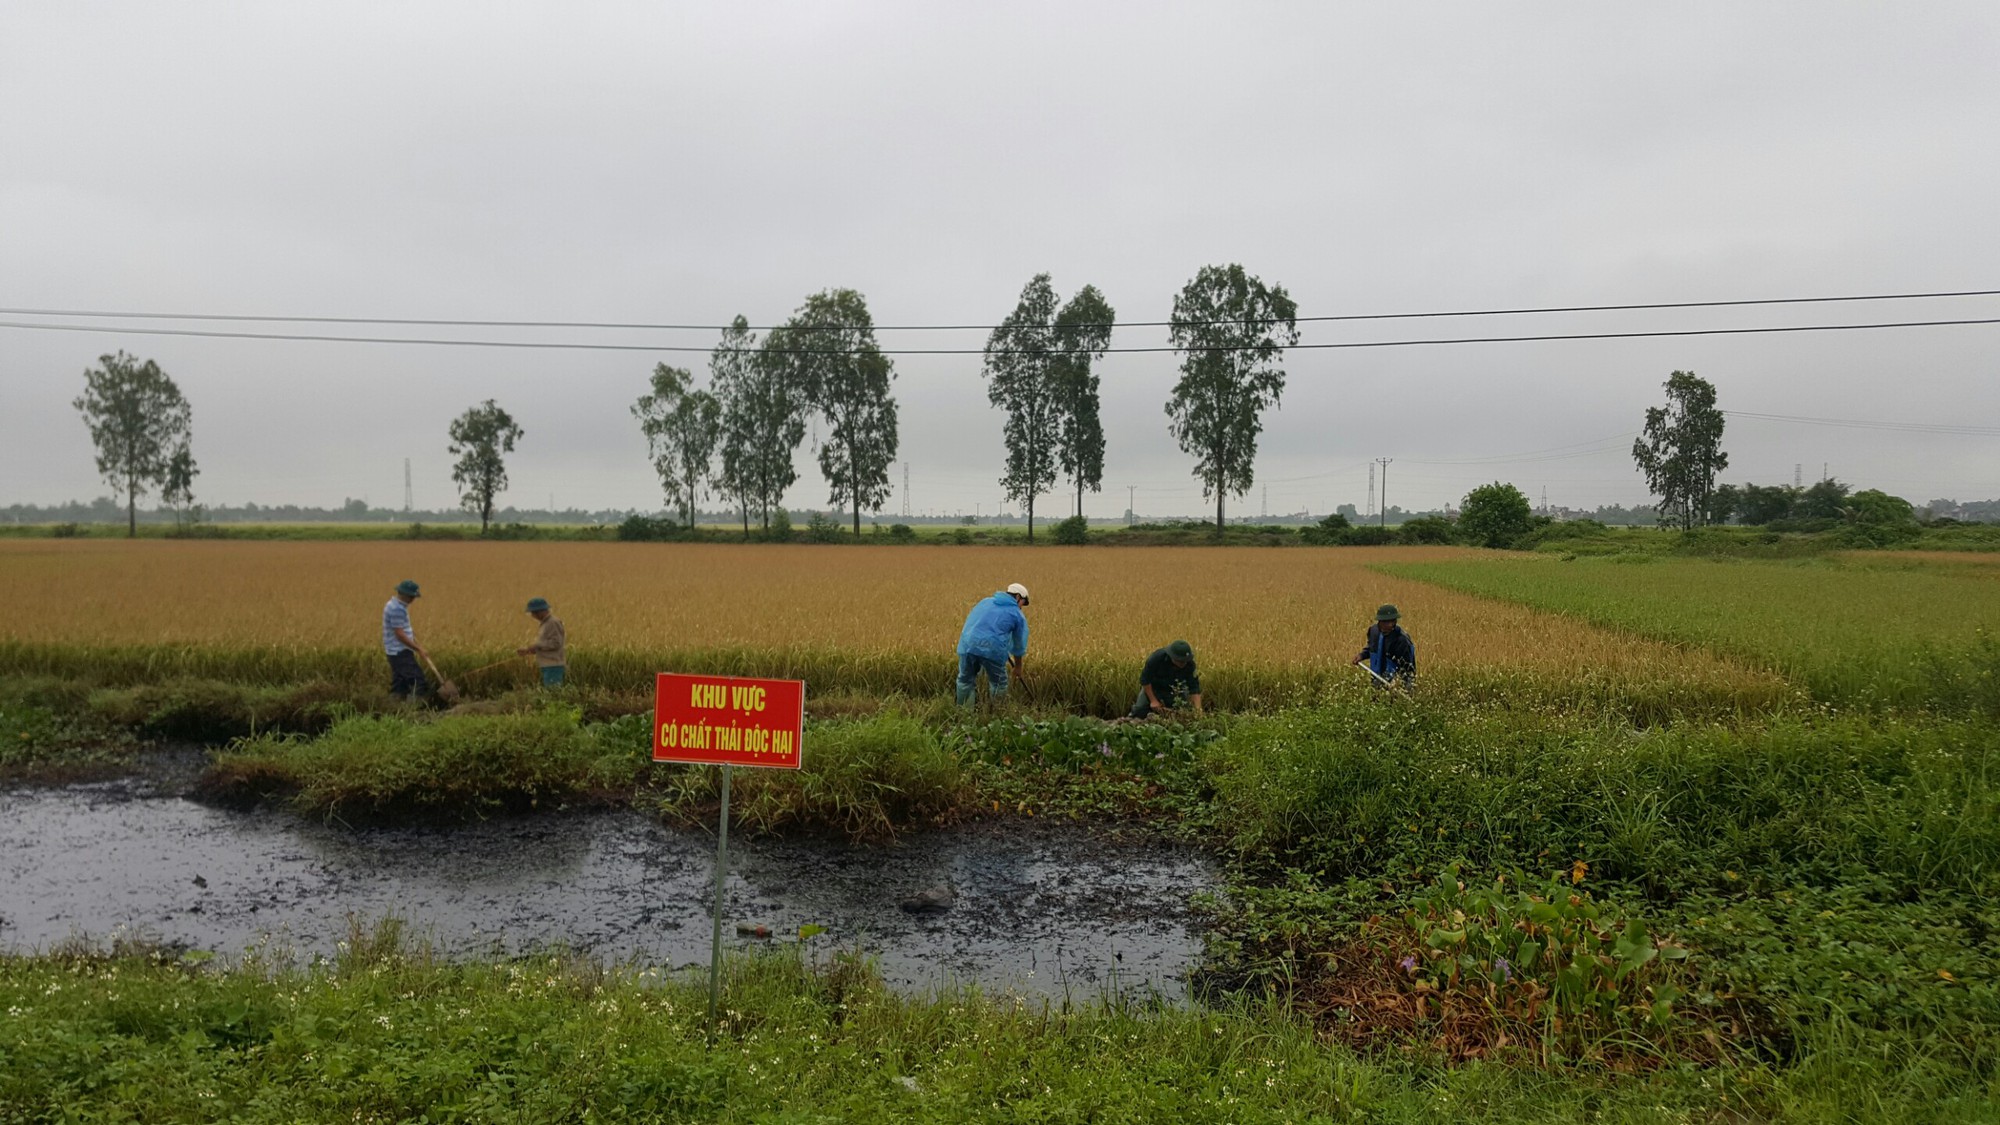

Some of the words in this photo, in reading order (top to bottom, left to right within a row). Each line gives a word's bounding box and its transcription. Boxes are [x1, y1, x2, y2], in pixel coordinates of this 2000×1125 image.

[691, 684, 727, 709] KHU
[732, 685, 766, 716] VỰC
[661, 718, 678, 748] CÓ
[680, 717, 712, 750] CHẤT
[715, 719, 742, 751] THẢI
[744, 723, 769, 758] ĐỘC
[772, 729, 793, 759] HẠI
